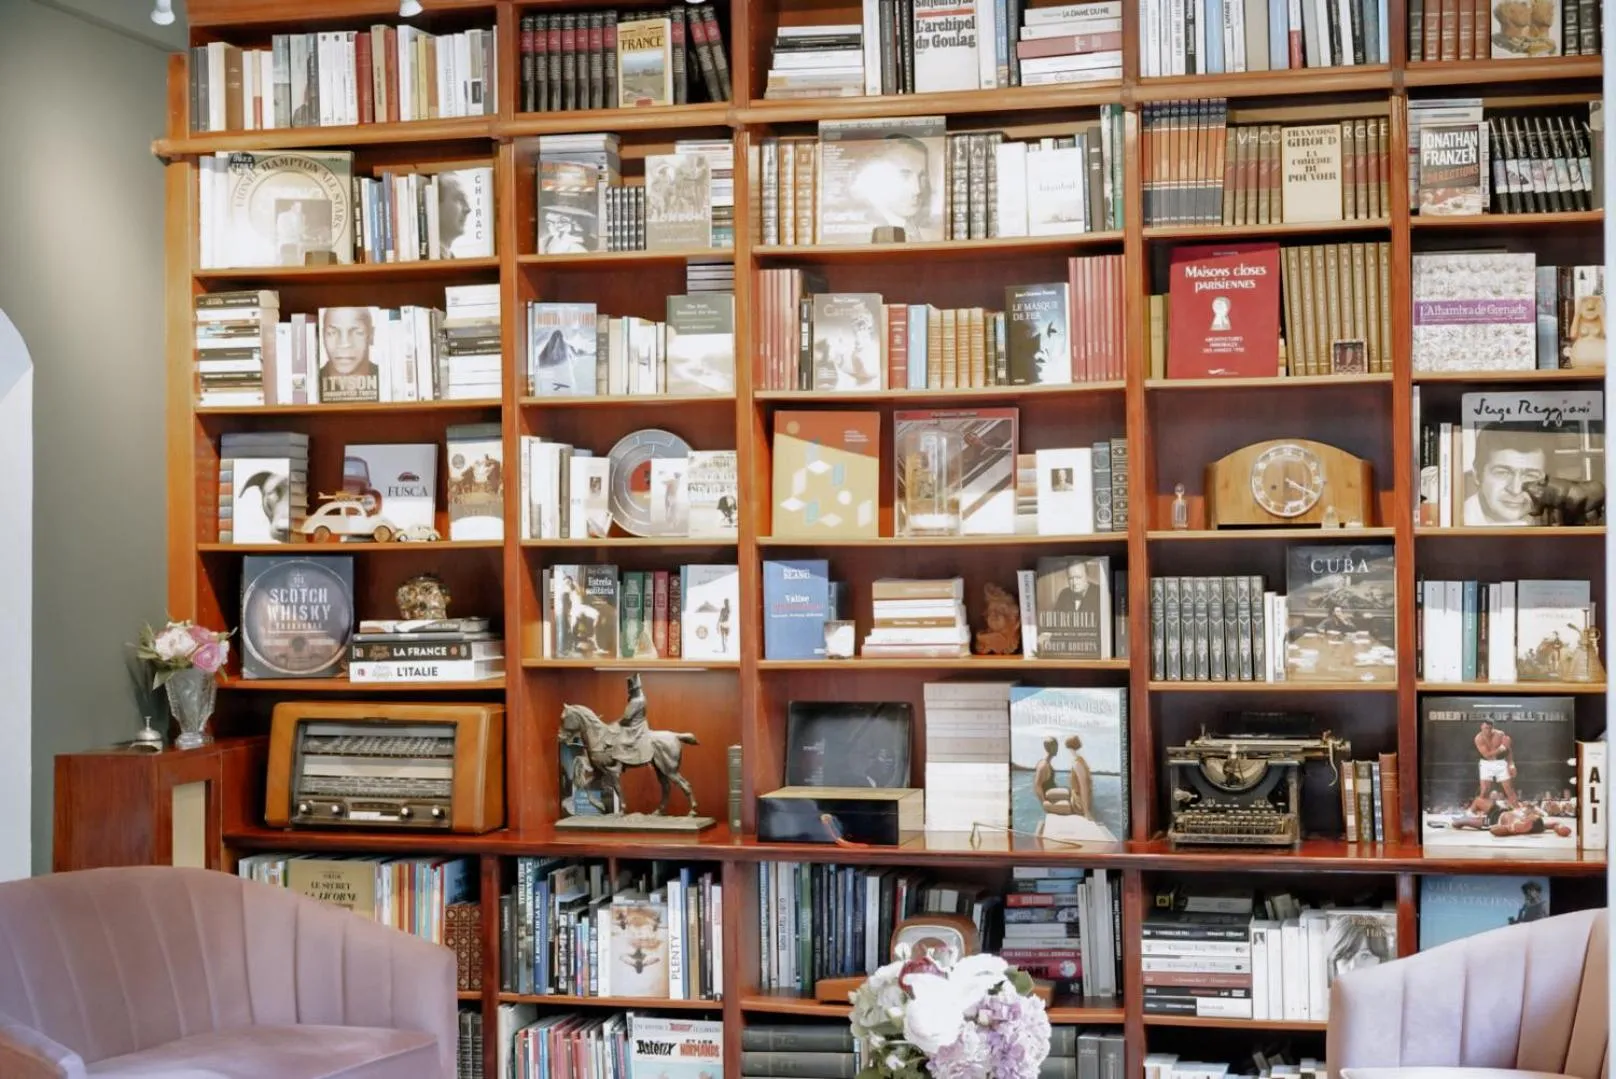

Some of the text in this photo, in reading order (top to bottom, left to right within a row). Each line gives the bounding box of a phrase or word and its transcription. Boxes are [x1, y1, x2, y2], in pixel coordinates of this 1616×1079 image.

[915, 16, 976, 33] L'archipel
[621, 35, 664, 50] FRANCE
[915, 33, 976, 49] du Goulag
[1288, 136, 1337, 147] GIROUD
[1421, 131, 1478, 150] JONATHAN
[261, 158, 319, 173] HAMPTON
[1423, 150, 1478, 166] FRANZEN
[1184, 263, 1267, 279] Maisons closes
[1195, 278, 1257, 293] parisiennes
[328, 375, 377, 391] TYSON
[1473, 398, 1592, 427] Serge Reggiani
[388, 485, 428, 497] FUSCA
[1310, 559, 1369, 574] CUBA
[269, 588, 328, 604] SCOTCH
[267, 604, 331, 621] WHISKY
[1040, 611, 1096, 628] CHURCHILL
[393, 646, 447, 657] LA FRANCE
[396, 666, 438, 677] L'ITALIE
[1589, 766, 1601, 824] ALI
[671, 934, 680, 980] PLENTY
[635, 1039, 677, 1057] Astérix
